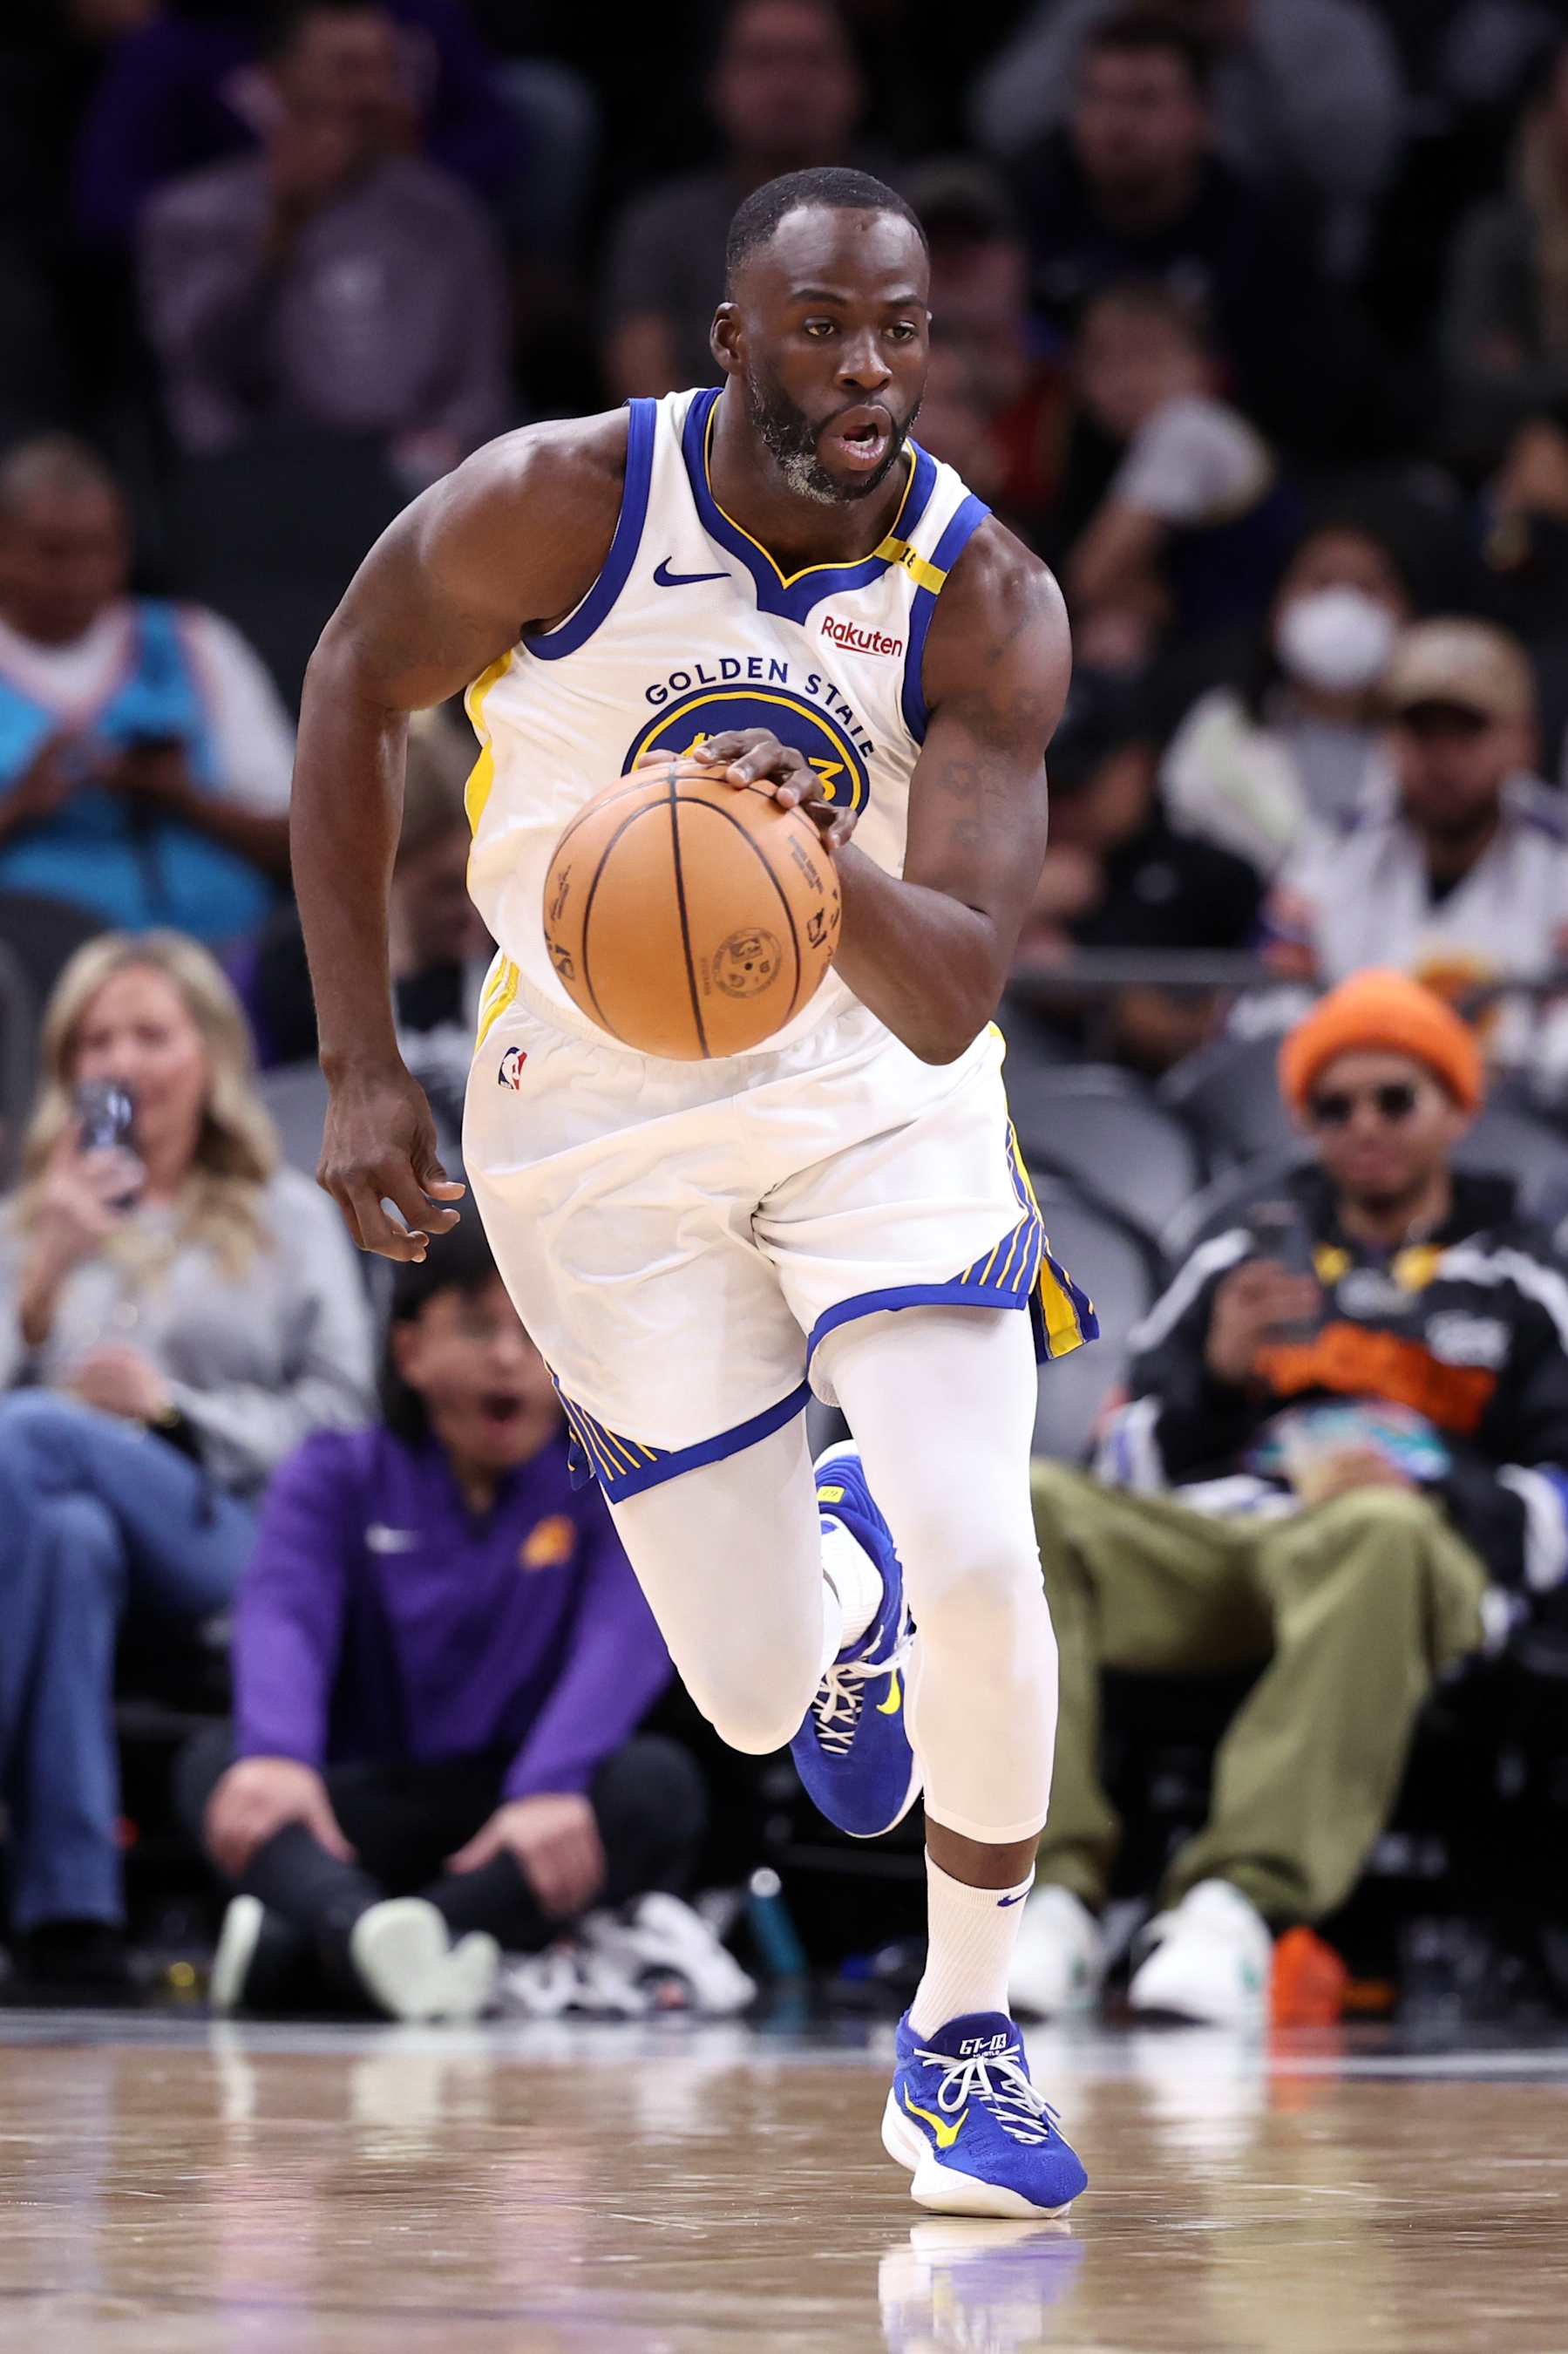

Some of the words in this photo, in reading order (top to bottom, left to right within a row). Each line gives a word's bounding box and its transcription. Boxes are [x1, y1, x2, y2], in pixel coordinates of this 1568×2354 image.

[821, 616, 903, 657] Rakuten
[645, 657, 789, 705] GOLDEN
[804, 673, 875, 759] STATE
